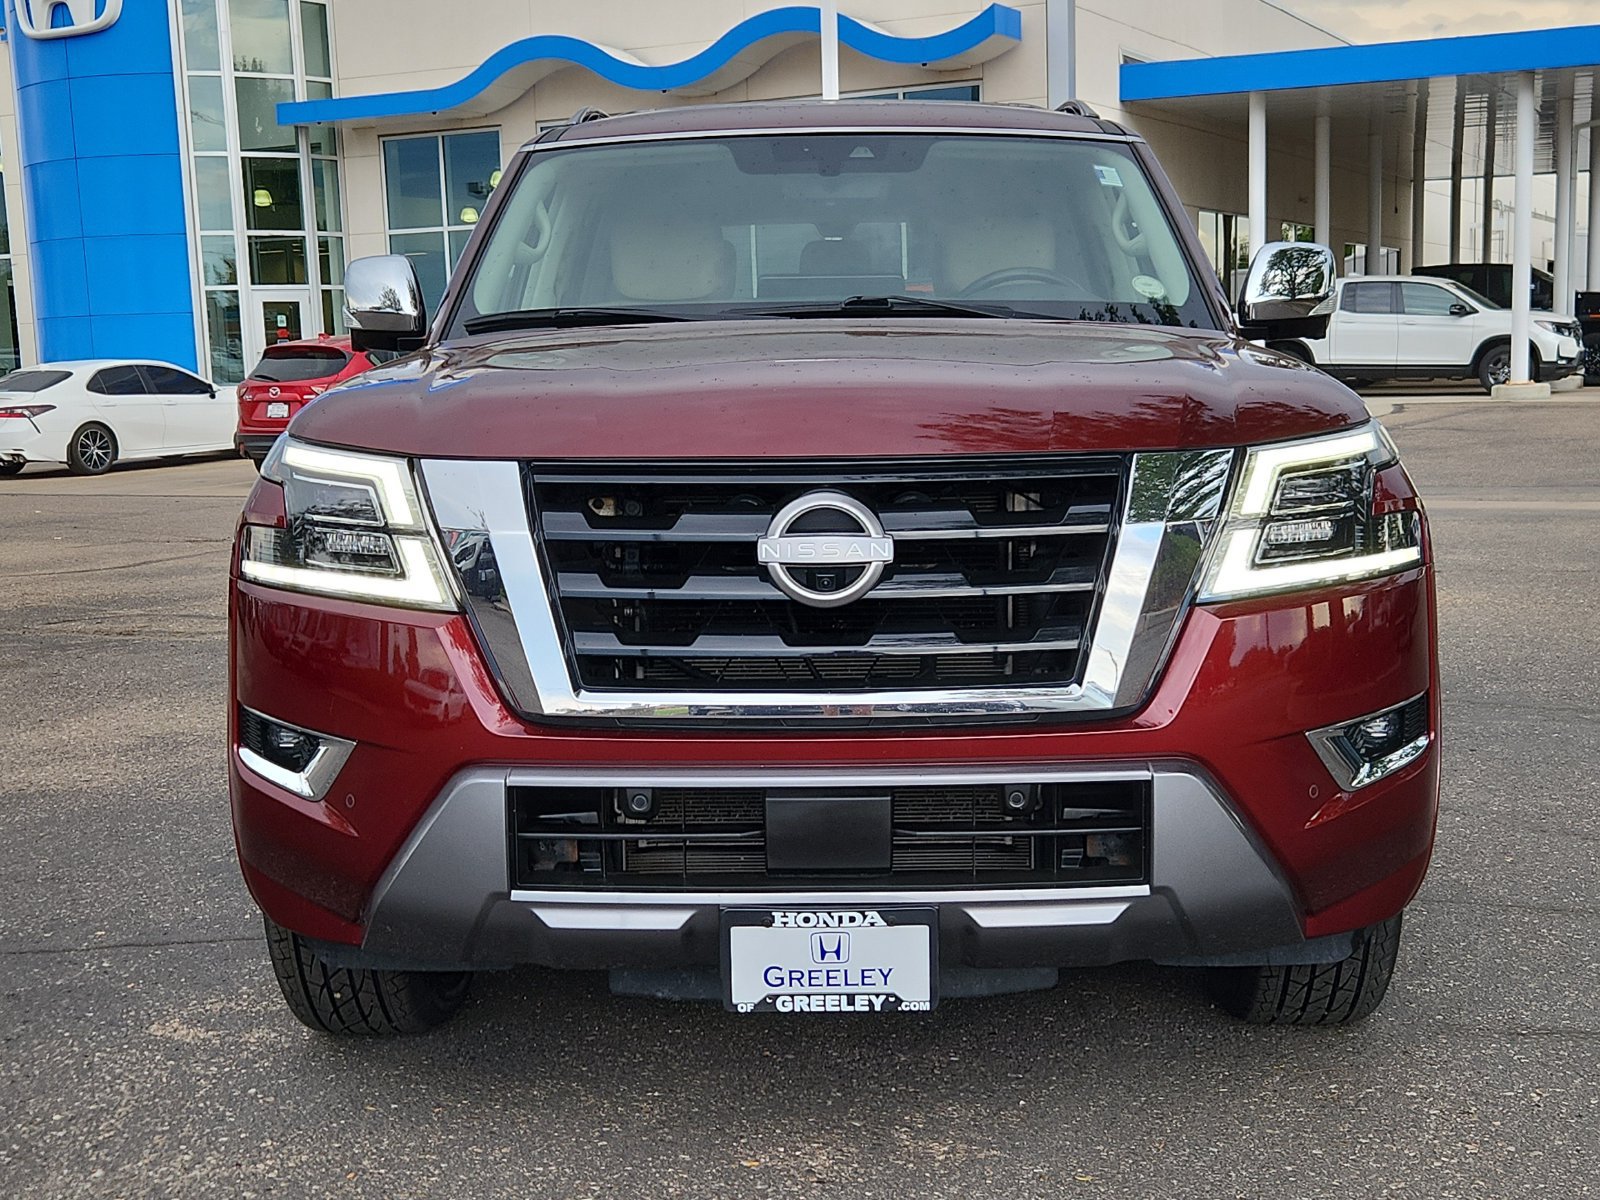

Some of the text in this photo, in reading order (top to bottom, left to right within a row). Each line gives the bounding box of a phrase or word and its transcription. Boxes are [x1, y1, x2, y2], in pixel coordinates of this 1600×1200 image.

[761, 542, 889, 559] NISSAN
[771, 911, 887, 928] HONDA
[763, 966, 894, 988] GREELEY
[737, 995, 931, 1013] OF GREELEY .COM
